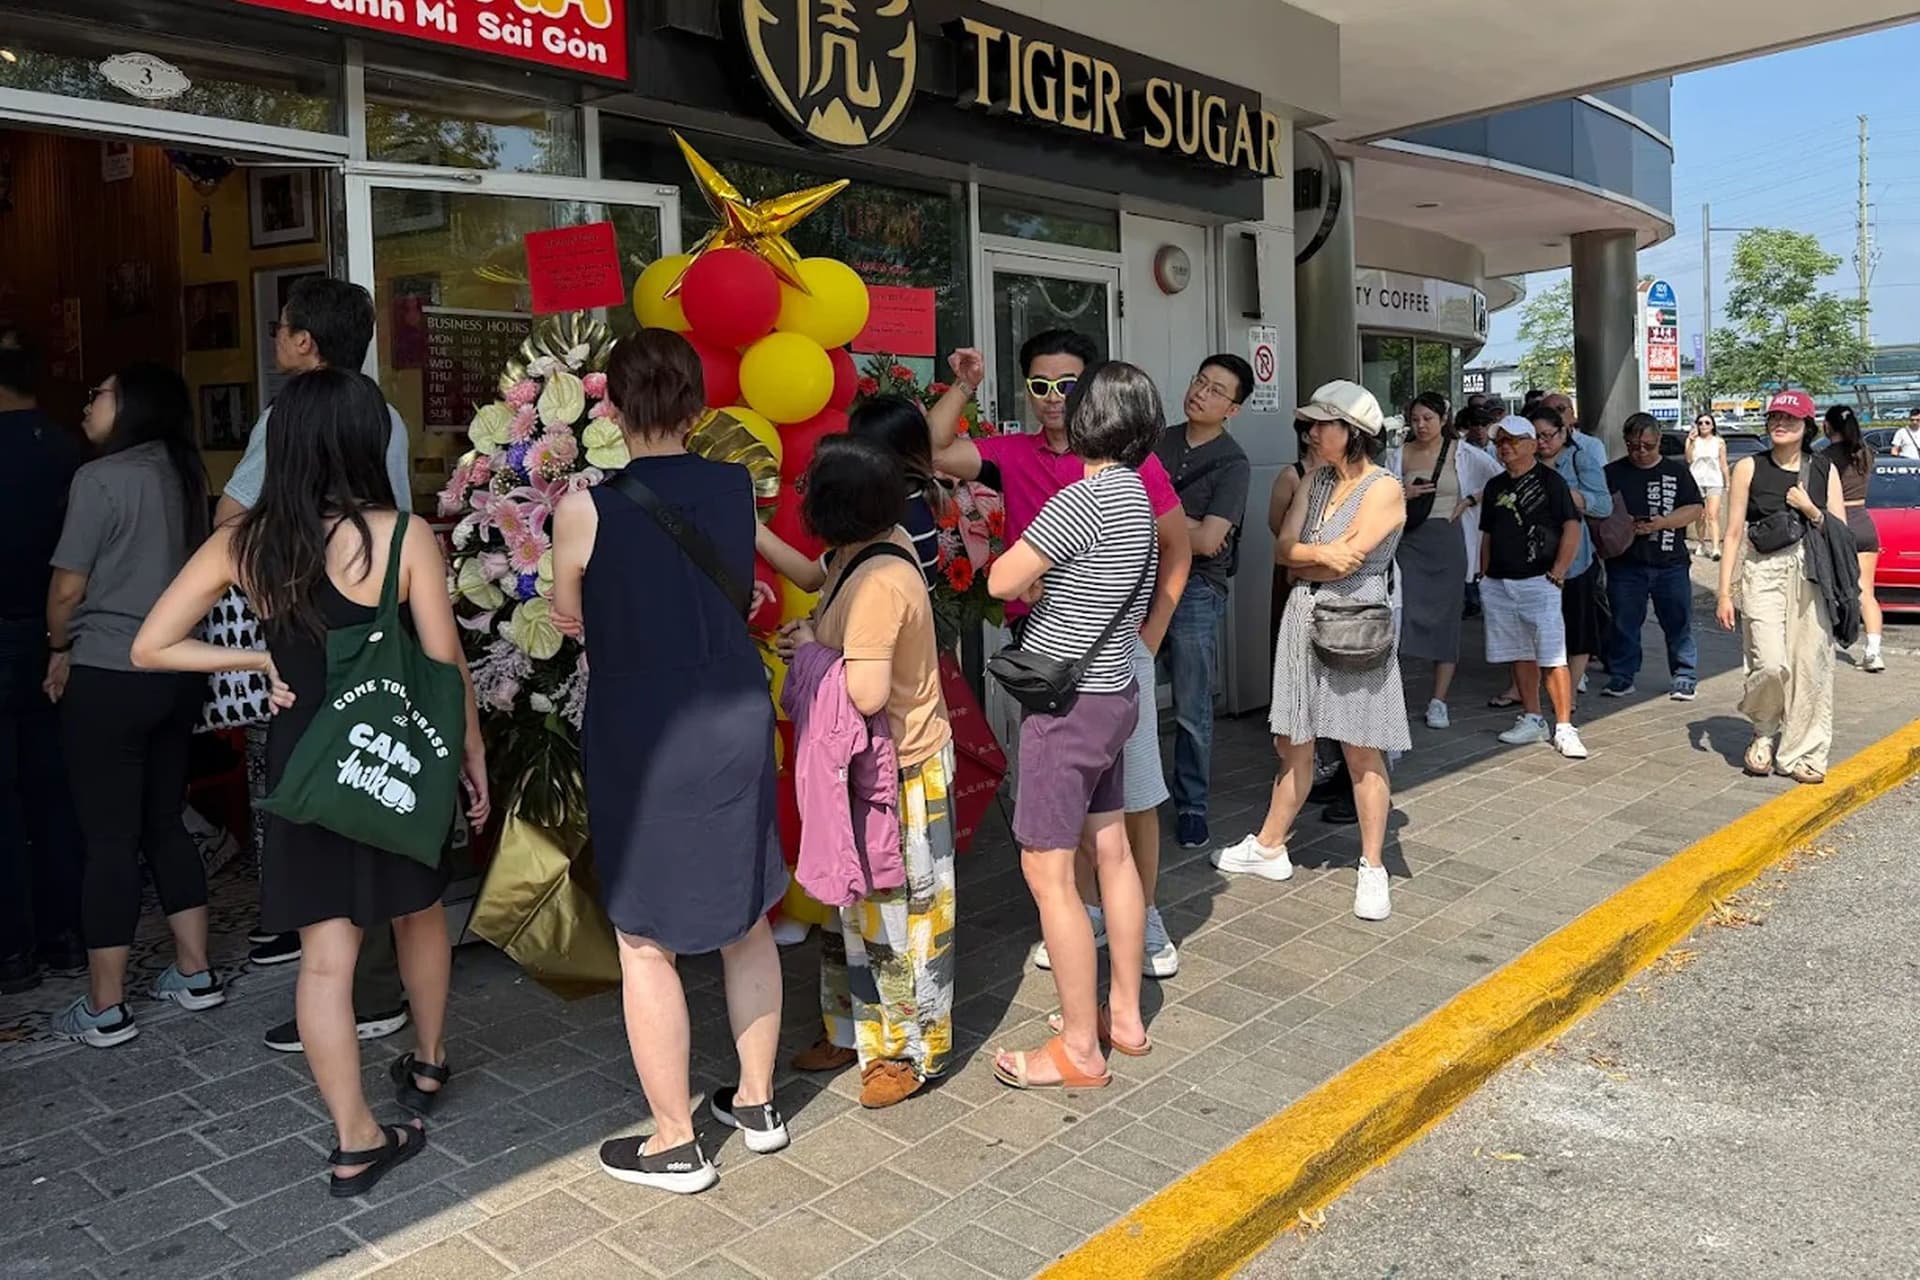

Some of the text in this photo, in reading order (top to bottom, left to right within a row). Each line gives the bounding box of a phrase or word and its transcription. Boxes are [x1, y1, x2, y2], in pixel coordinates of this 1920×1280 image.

[415, 0, 458, 33] Mì
[478, 12, 532, 48] Sài
[541, 26, 608, 63] Gòn
[139, 66, 153, 86] 3
[962, 16, 1285, 178] TIGER SUGAR
[1379, 289, 1430, 313] COFFEE
[426, 316, 530, 334] BUSINESS HOURS
[428, 334, 454, 343] MON
[429, 346, 448, 356] TUE
[429, 358, 453, 369] WED
[1661, 474, 1677, 552] AEROPALE
[332, 679, 377, 711] COME
[411, 710, 449, 758] GRASS
